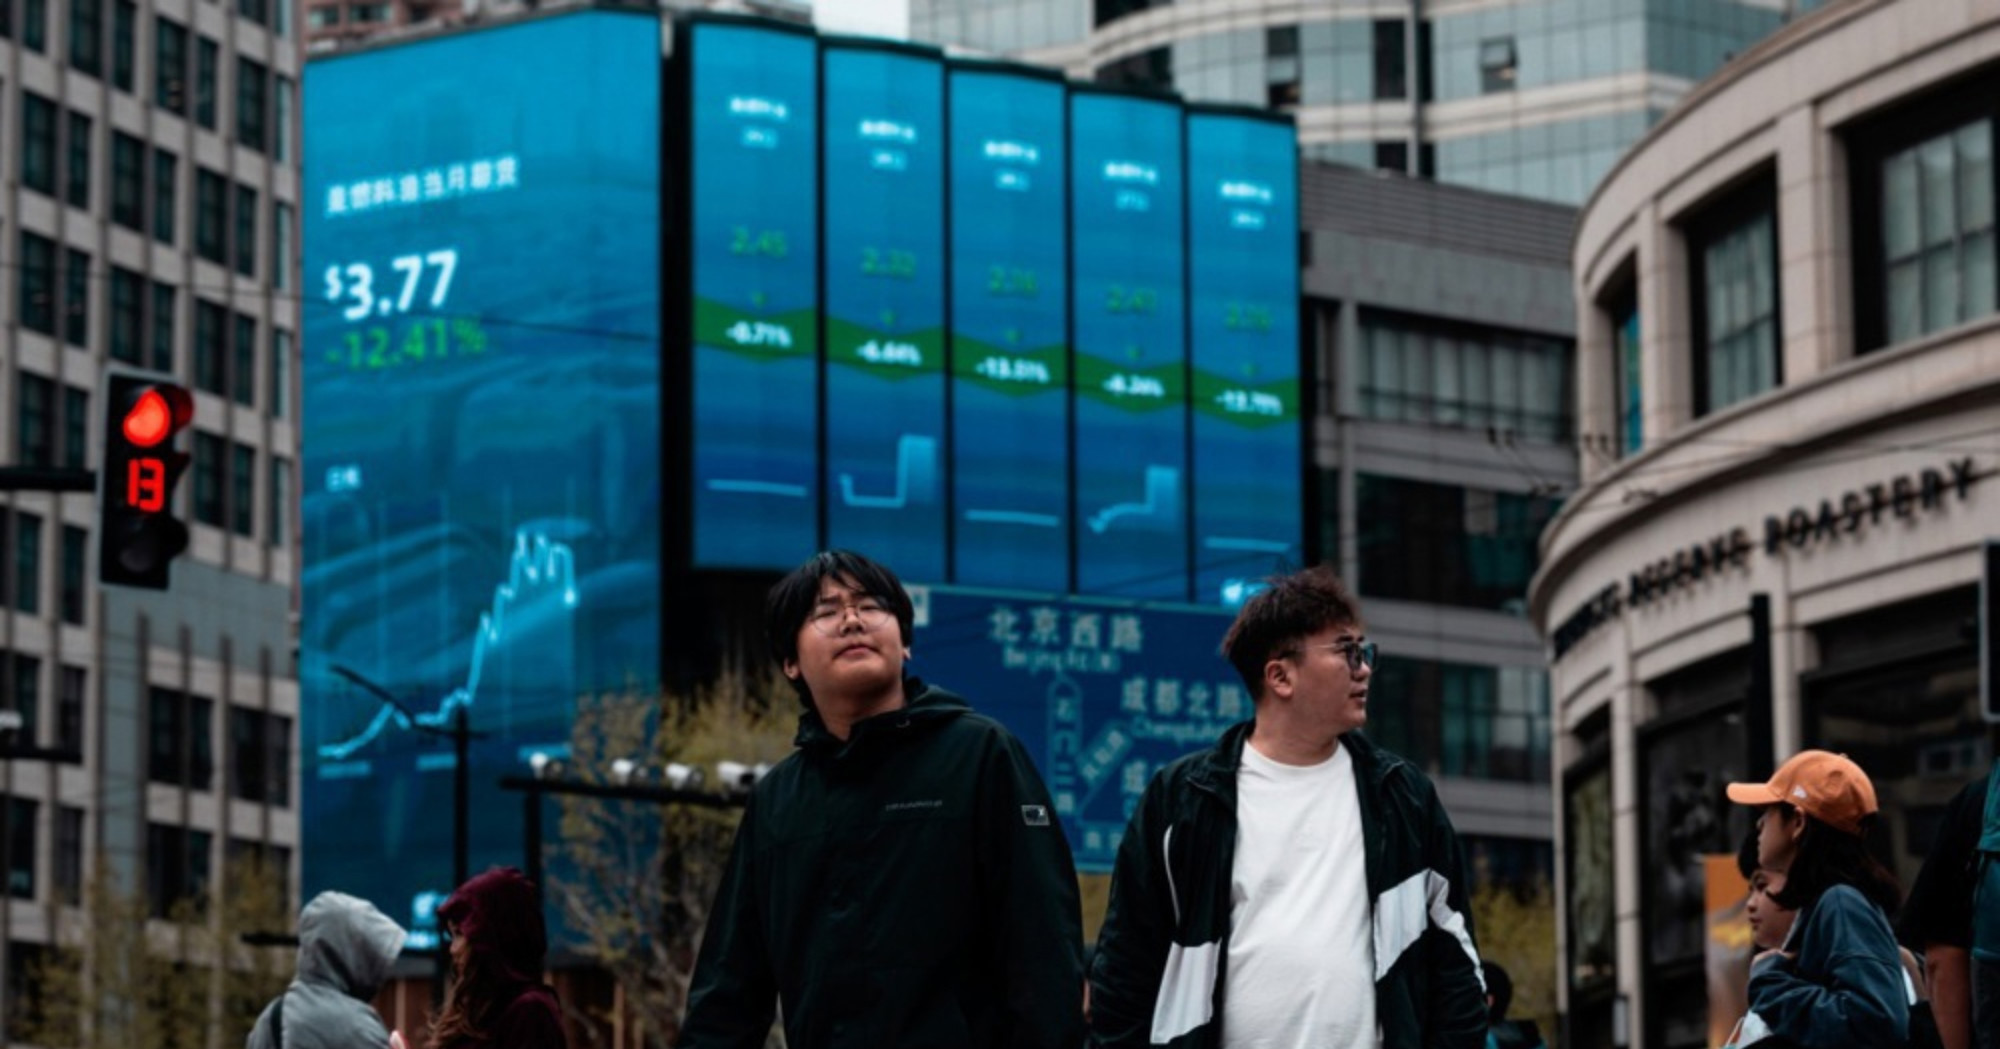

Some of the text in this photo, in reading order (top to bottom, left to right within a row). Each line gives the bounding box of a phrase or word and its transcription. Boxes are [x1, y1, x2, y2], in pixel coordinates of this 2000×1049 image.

[324, 249, 457, 321] $3.77
[324, 317, 487, 369] -12.41%
[128, 458, 165, 512] 13
[989, 606, 1143, 653] 北京西路
